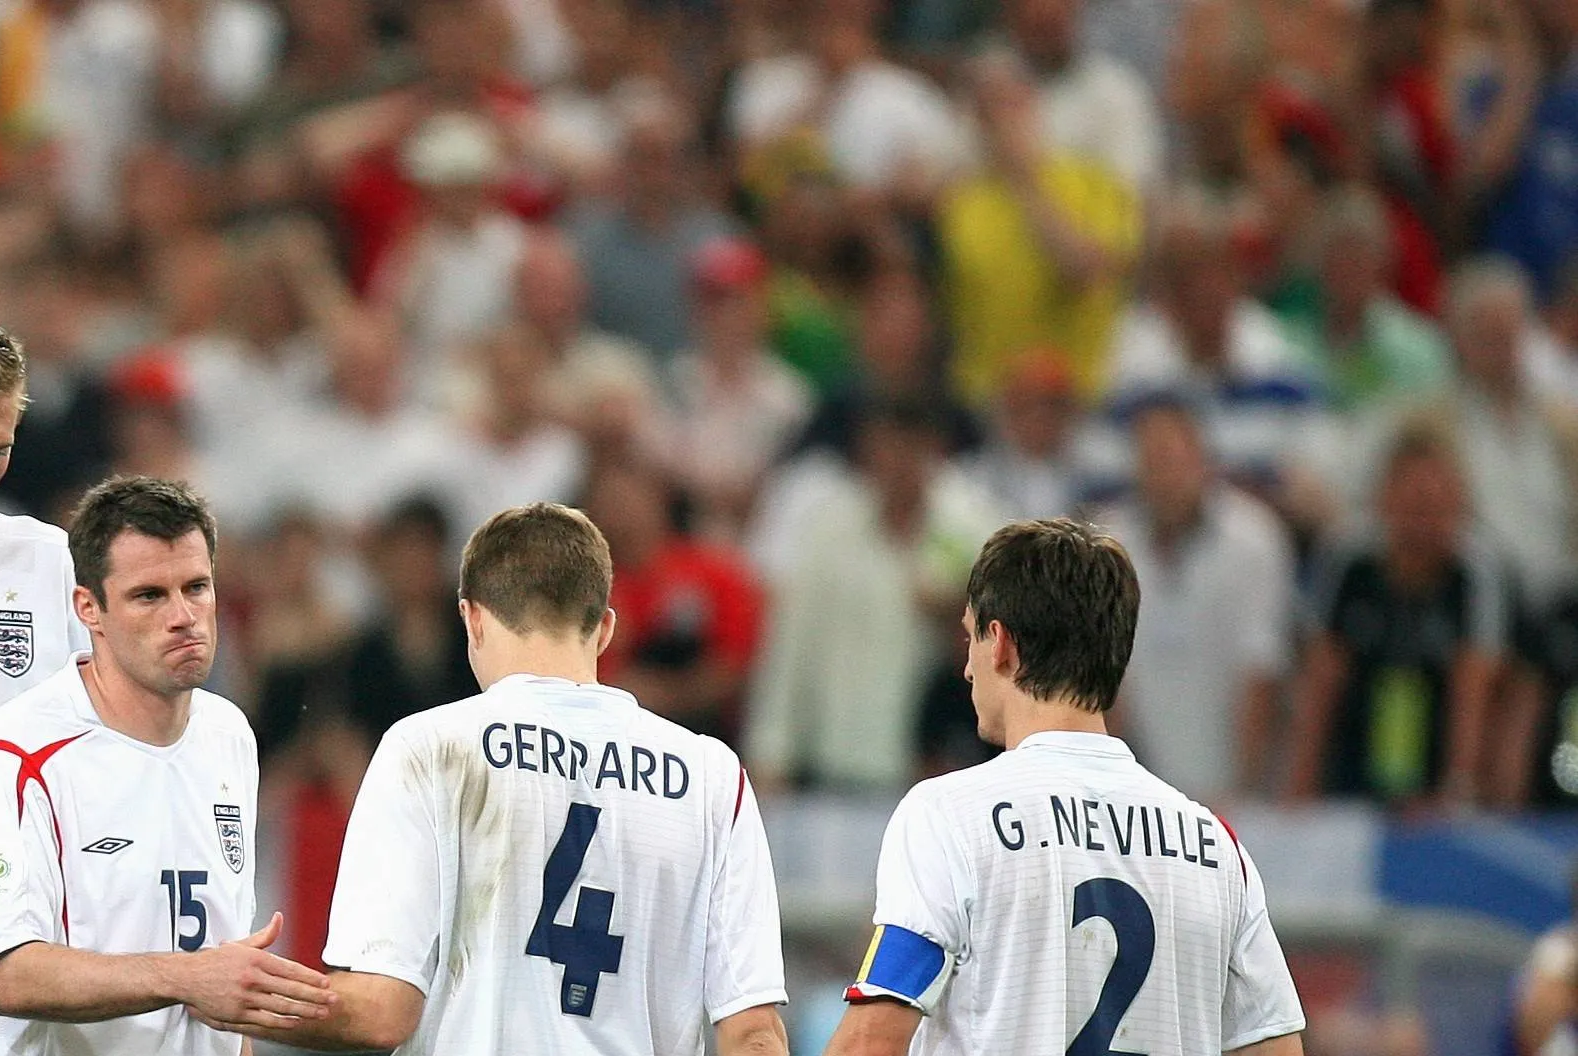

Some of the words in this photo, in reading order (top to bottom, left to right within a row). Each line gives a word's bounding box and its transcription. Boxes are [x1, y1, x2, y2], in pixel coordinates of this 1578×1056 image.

[482, 722, 689, 799] GERRARD
[161, 870, 208, 953] 15
[525, 802, 624, 1017] 4
